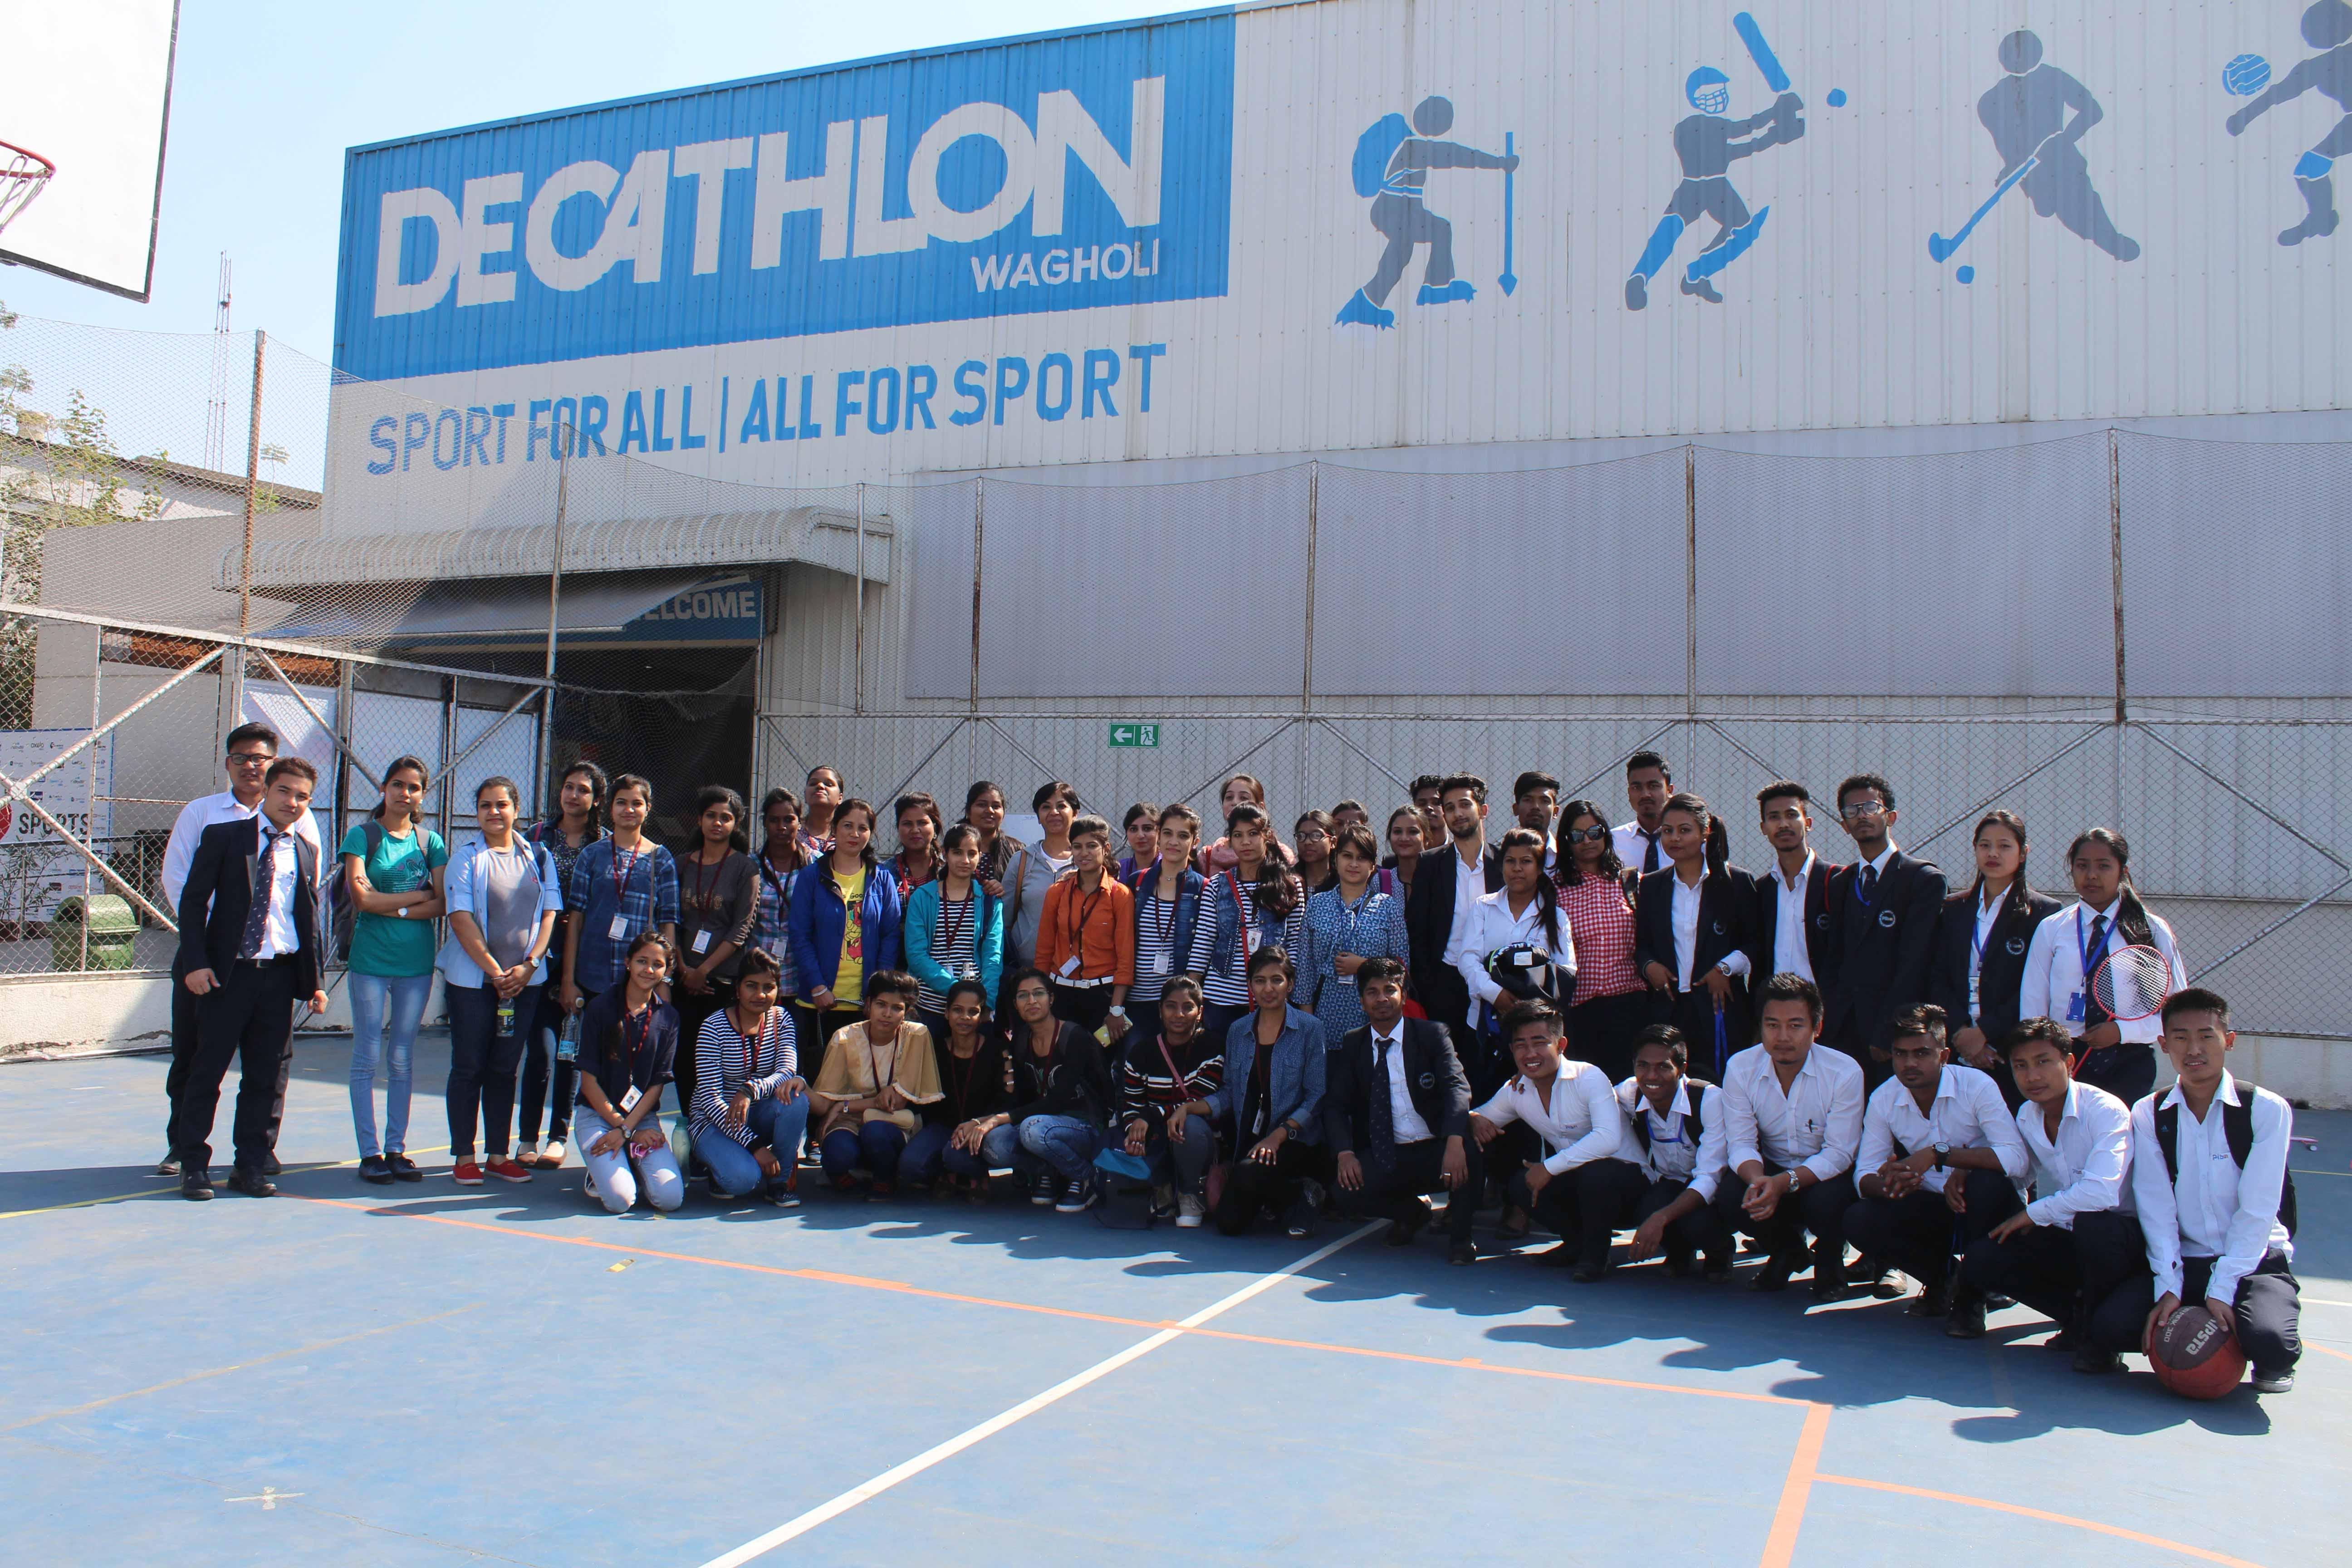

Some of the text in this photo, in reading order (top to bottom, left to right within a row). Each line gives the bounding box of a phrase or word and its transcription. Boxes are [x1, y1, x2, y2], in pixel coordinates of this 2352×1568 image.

[375, 74, 1166, 318] DECATHLON
[970, 238, 1160, 293] WAGHOLI
[367, 402, 516, 475] SPORT
[526, 393, 610, 462] FOR
[617, 385, 706, 454] ALL
[740, 374, 822, 445] ALL
[835, 365, 938, 437] FOR
[948, 343, 1166, 427] SPORT
[634, 591, 756, 620] LCOME
[2163, 1327, 2174, 1343] 300
